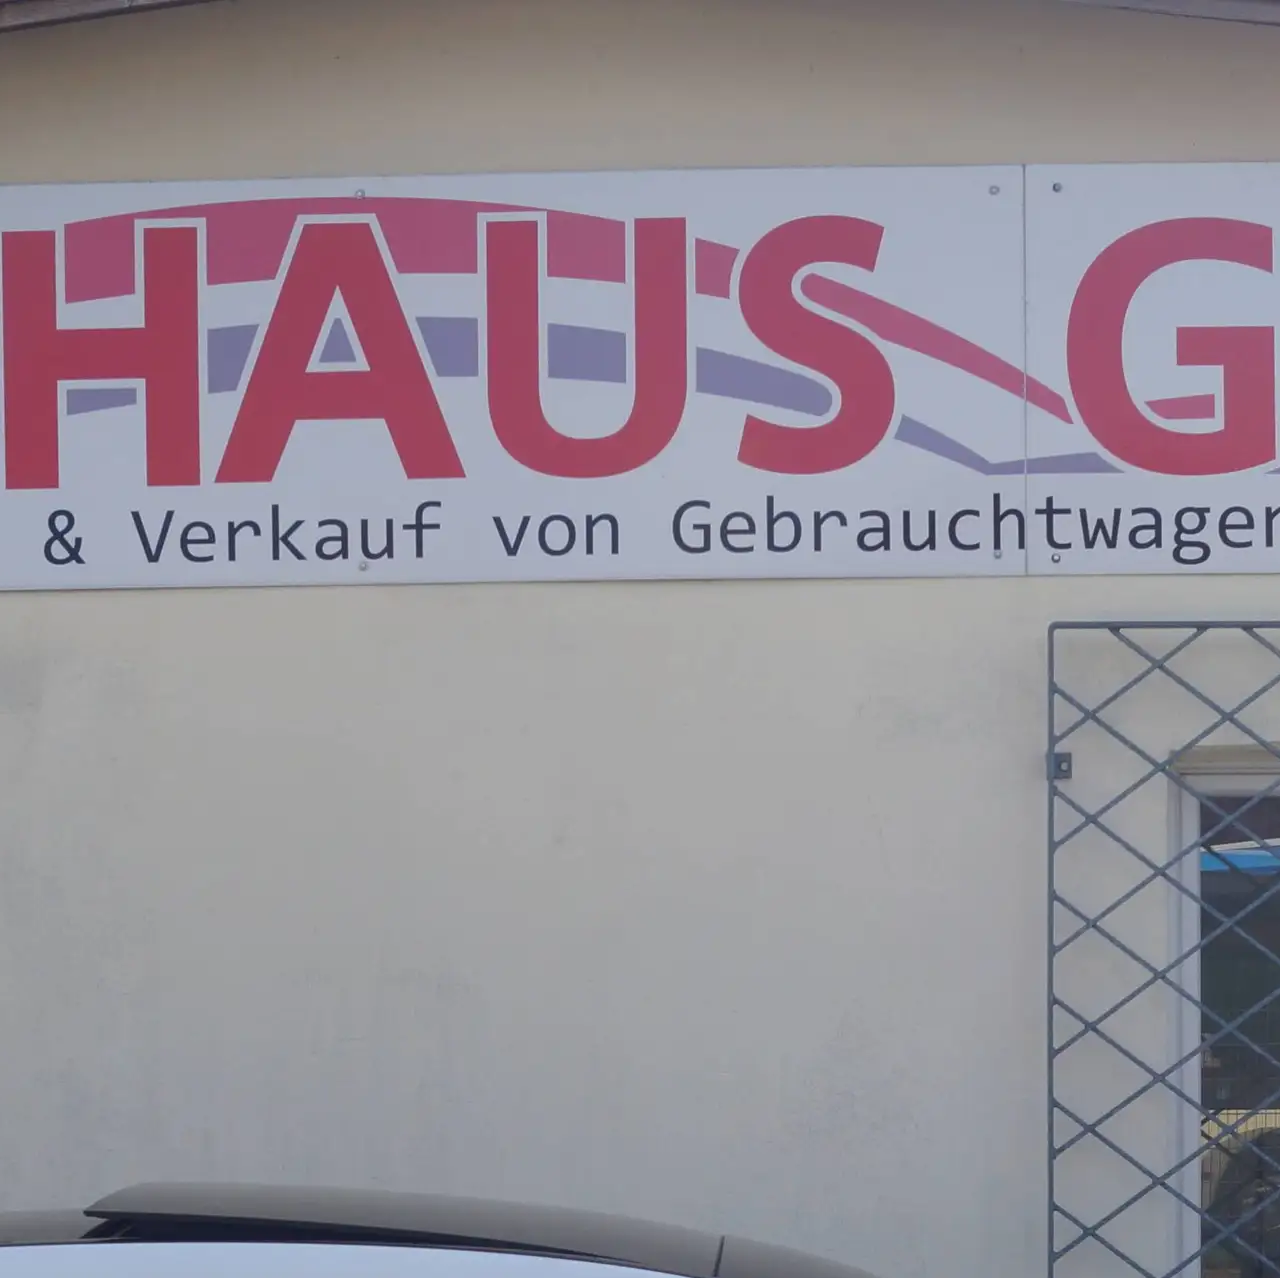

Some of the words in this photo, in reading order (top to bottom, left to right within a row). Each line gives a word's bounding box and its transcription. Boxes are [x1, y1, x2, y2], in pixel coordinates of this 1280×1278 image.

[43, 509, 86, 565] &
[131, 501, 442, 564] Verkauf
[493, 513, 620, 556] von
